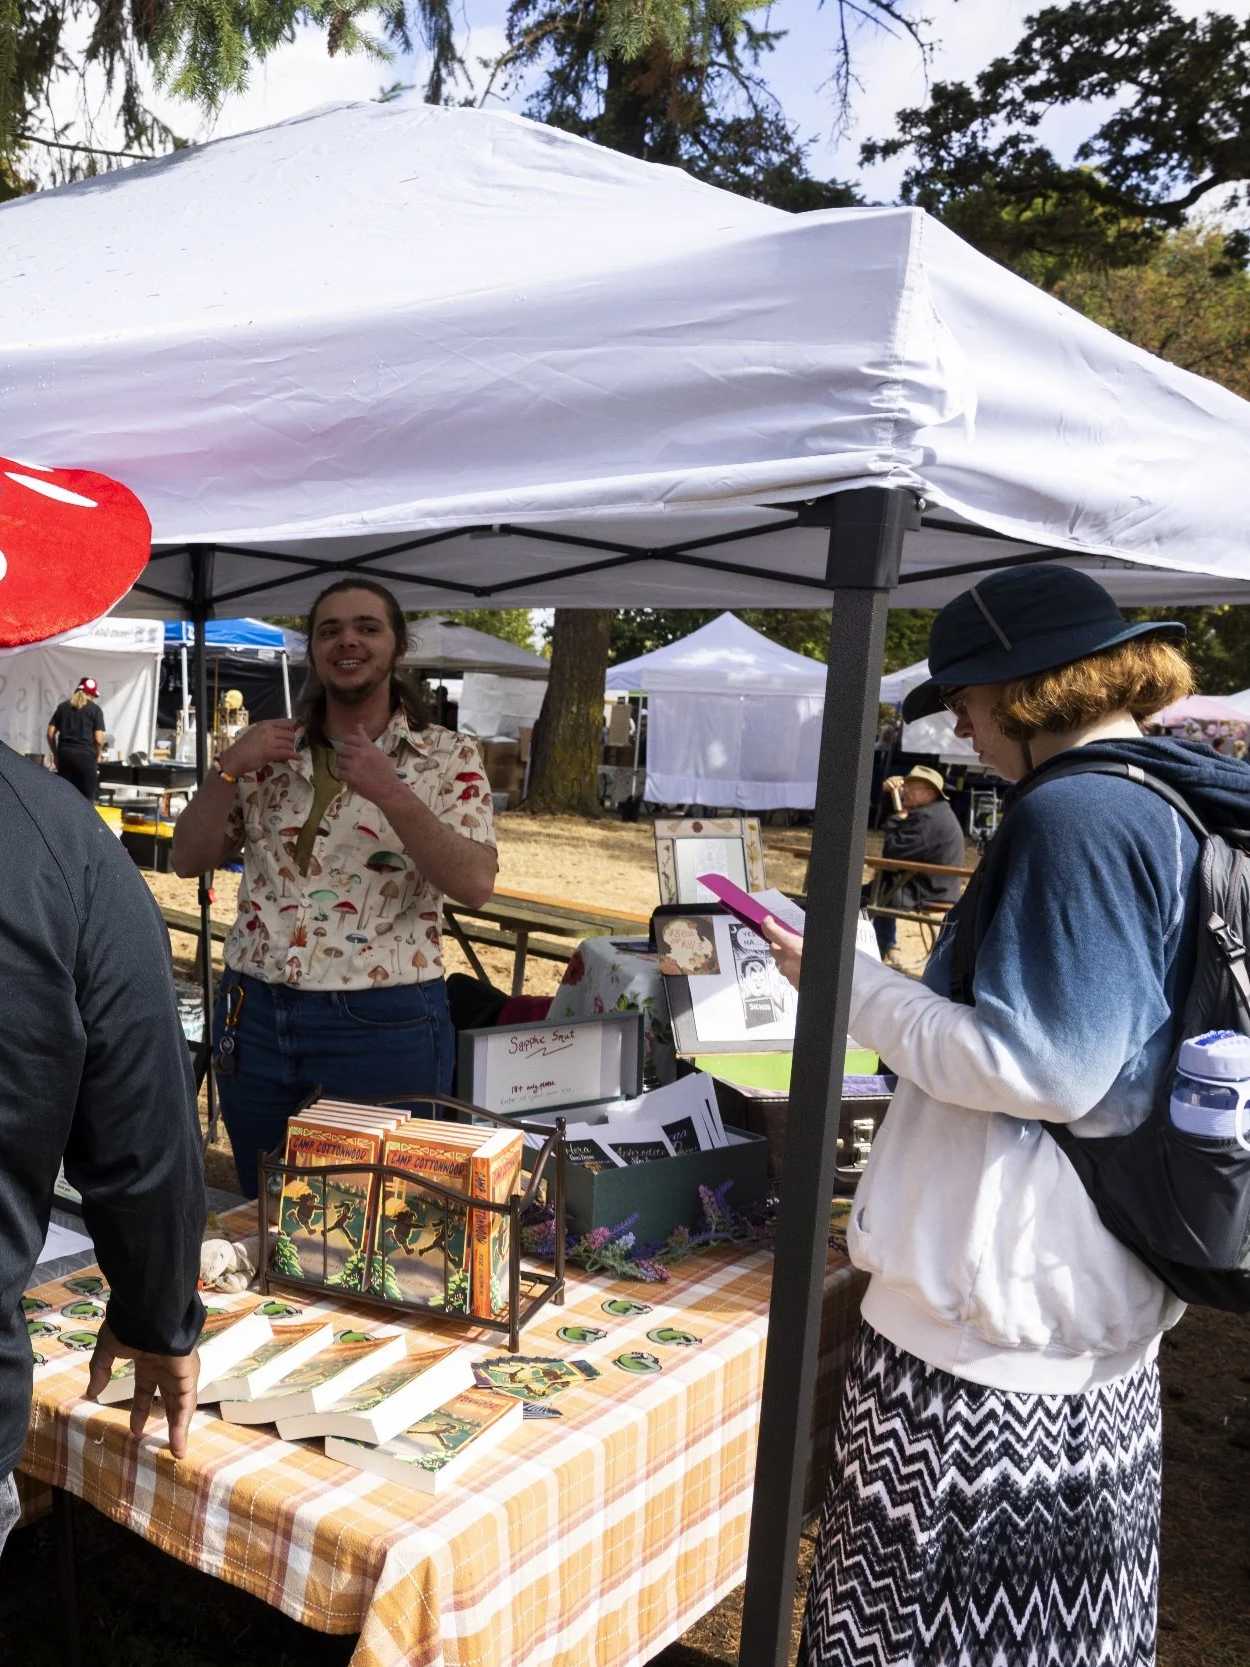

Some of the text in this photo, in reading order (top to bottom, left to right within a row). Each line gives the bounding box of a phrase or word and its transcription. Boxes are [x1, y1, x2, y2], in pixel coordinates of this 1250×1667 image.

[508, 1030, 576, 1055] Sapphic Smut
[511, 1084, 523, 1095] 18+
[293, 1137, 367, 1161] CAMP COTTONWOOD
[391, 1153, 464, 1176] CAMP COTTONWOOD
[475, 1170, 487, 1193] CAMP
[475, 1194, 487, 1246] CTONWOOD
